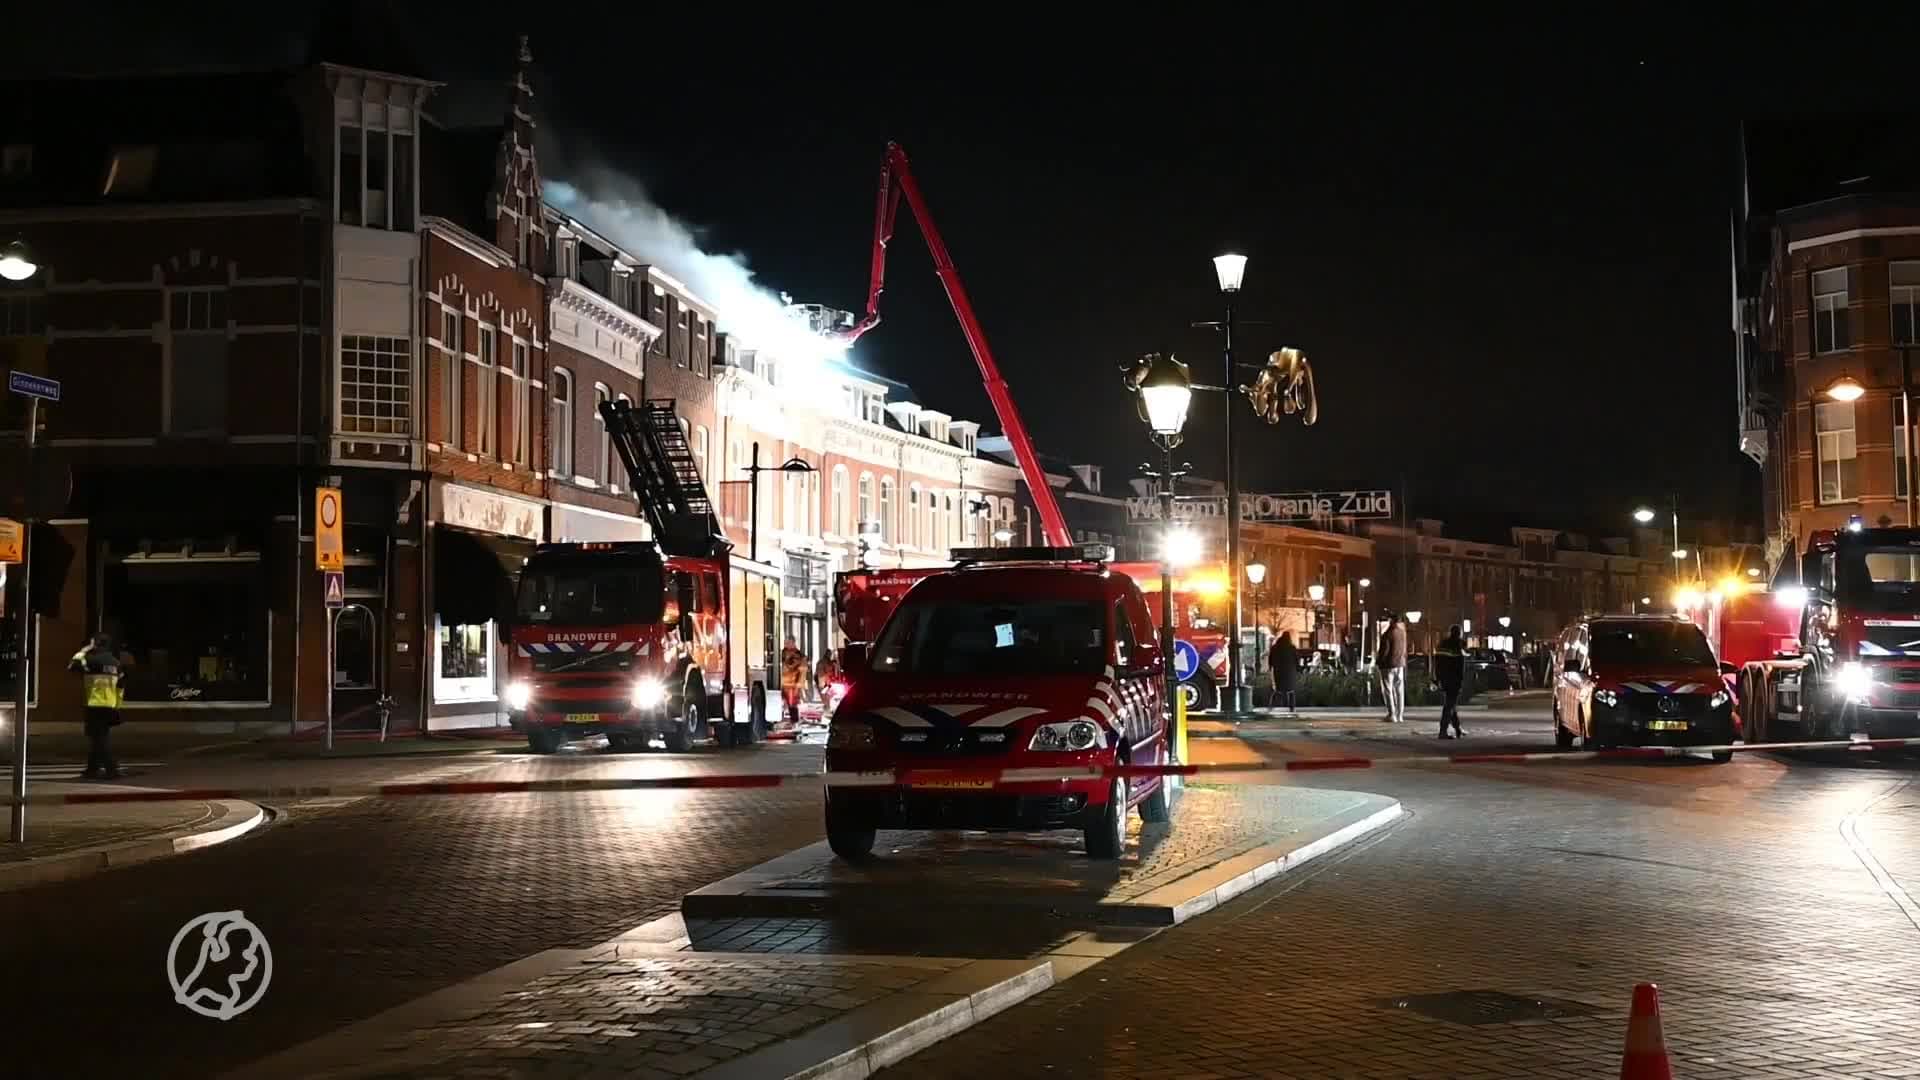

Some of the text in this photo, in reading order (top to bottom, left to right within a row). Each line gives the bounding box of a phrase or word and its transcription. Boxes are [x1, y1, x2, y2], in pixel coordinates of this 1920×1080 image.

[1127, 497, 1216, 519] Wekom
[1255, 493, 1332, 520] Oranje
[1340, 491, 1390, 513] Zuid
[547, 632, 617, 643] BRANDWEER
